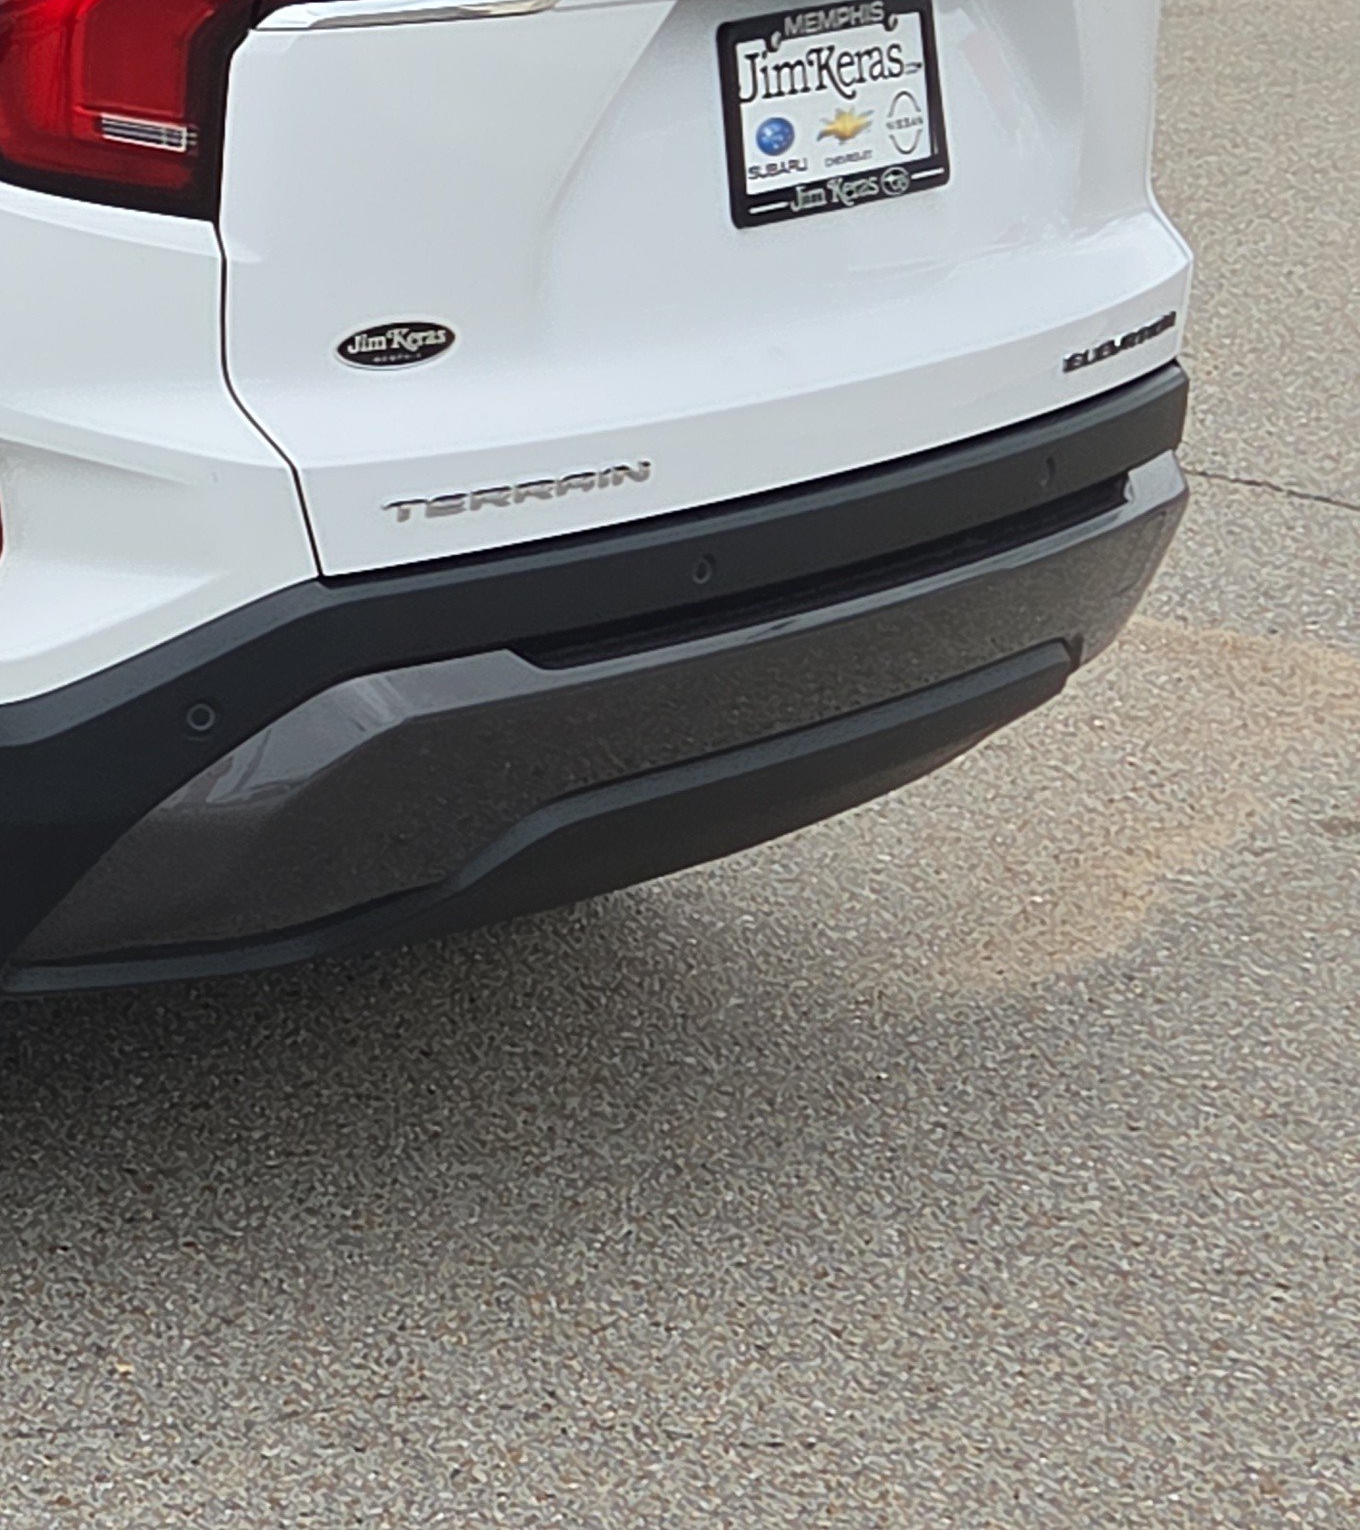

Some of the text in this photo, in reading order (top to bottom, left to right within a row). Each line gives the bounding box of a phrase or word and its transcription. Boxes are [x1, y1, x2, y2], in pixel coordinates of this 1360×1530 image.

[783, 0, 884, 37] MEMPHIS
[747, 157, 809, 181] SUBARU
[380, 459, 652, 523] TERRAIN
